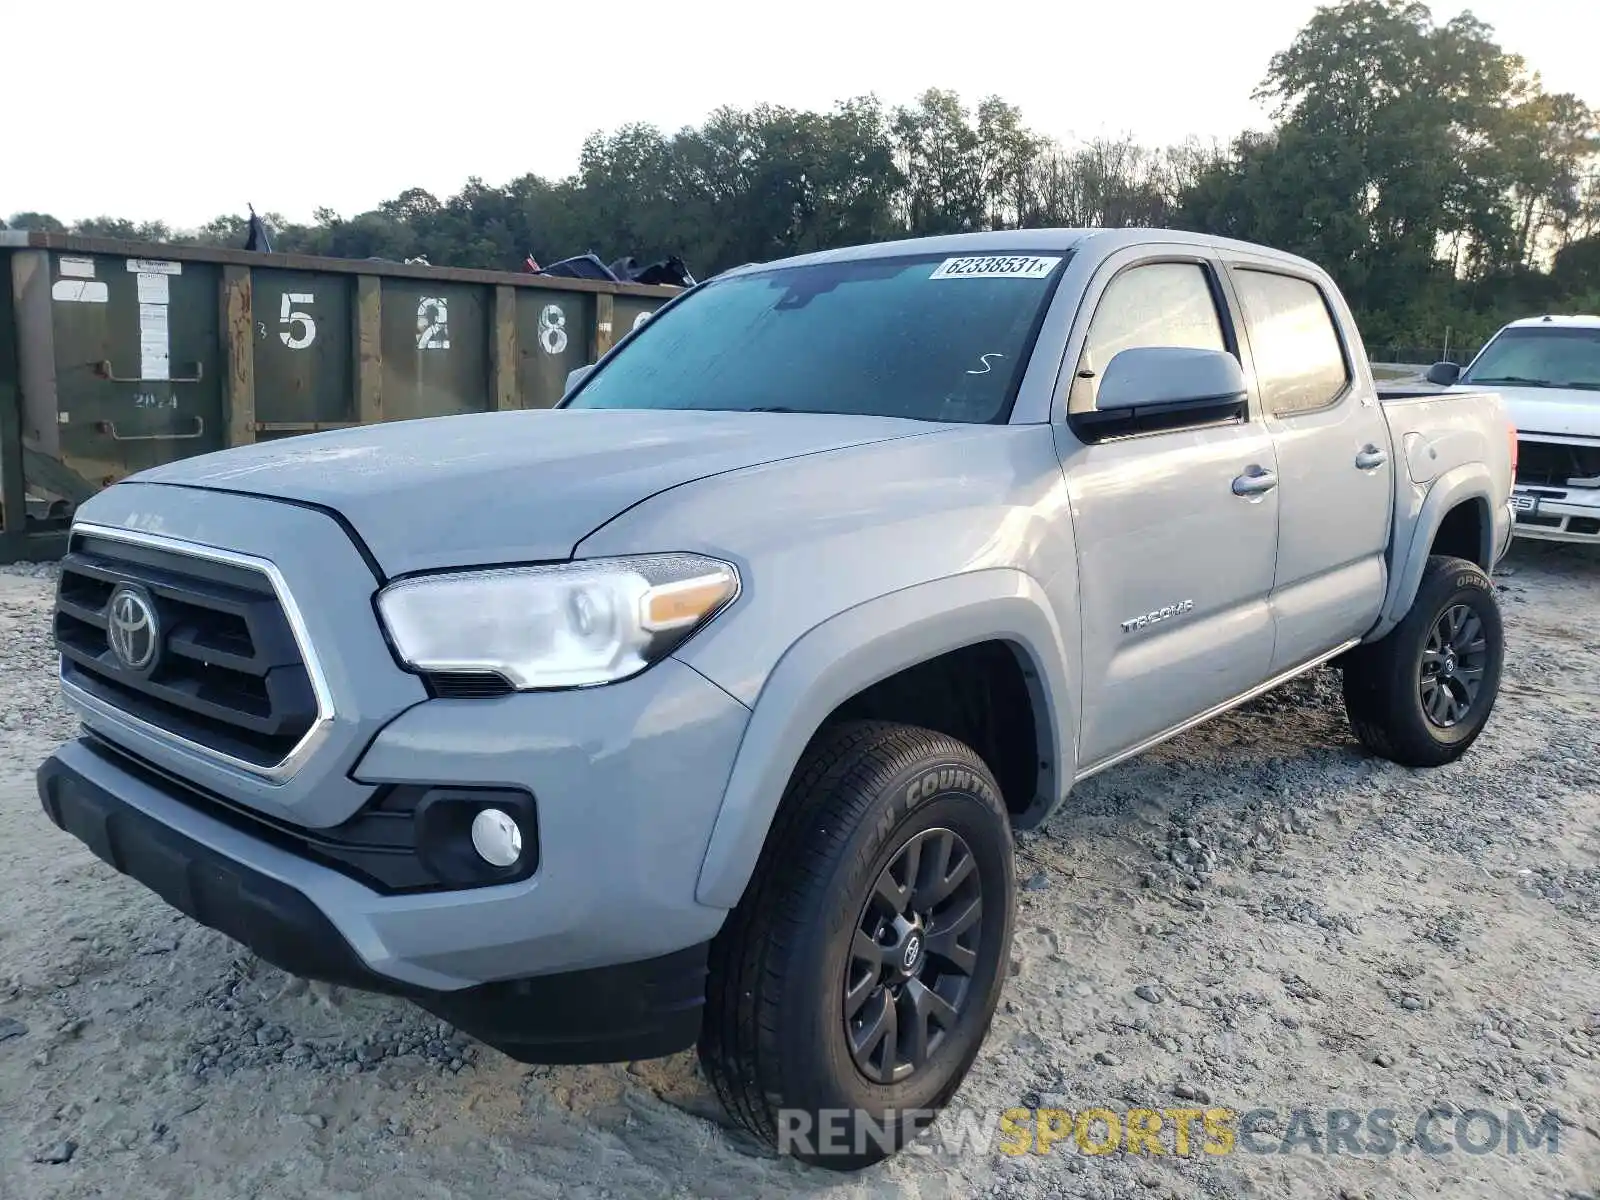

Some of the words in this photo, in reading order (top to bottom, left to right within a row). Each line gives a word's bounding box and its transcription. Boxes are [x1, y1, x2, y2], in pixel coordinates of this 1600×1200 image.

[280, 293, 316, 349] 5
[416, 297, 450, 349] 2
[538, 304, 568, 354] 8
[1457, 575, 1488, 589] OPEN
[1120, 599, 1194, 633] TACOMA
